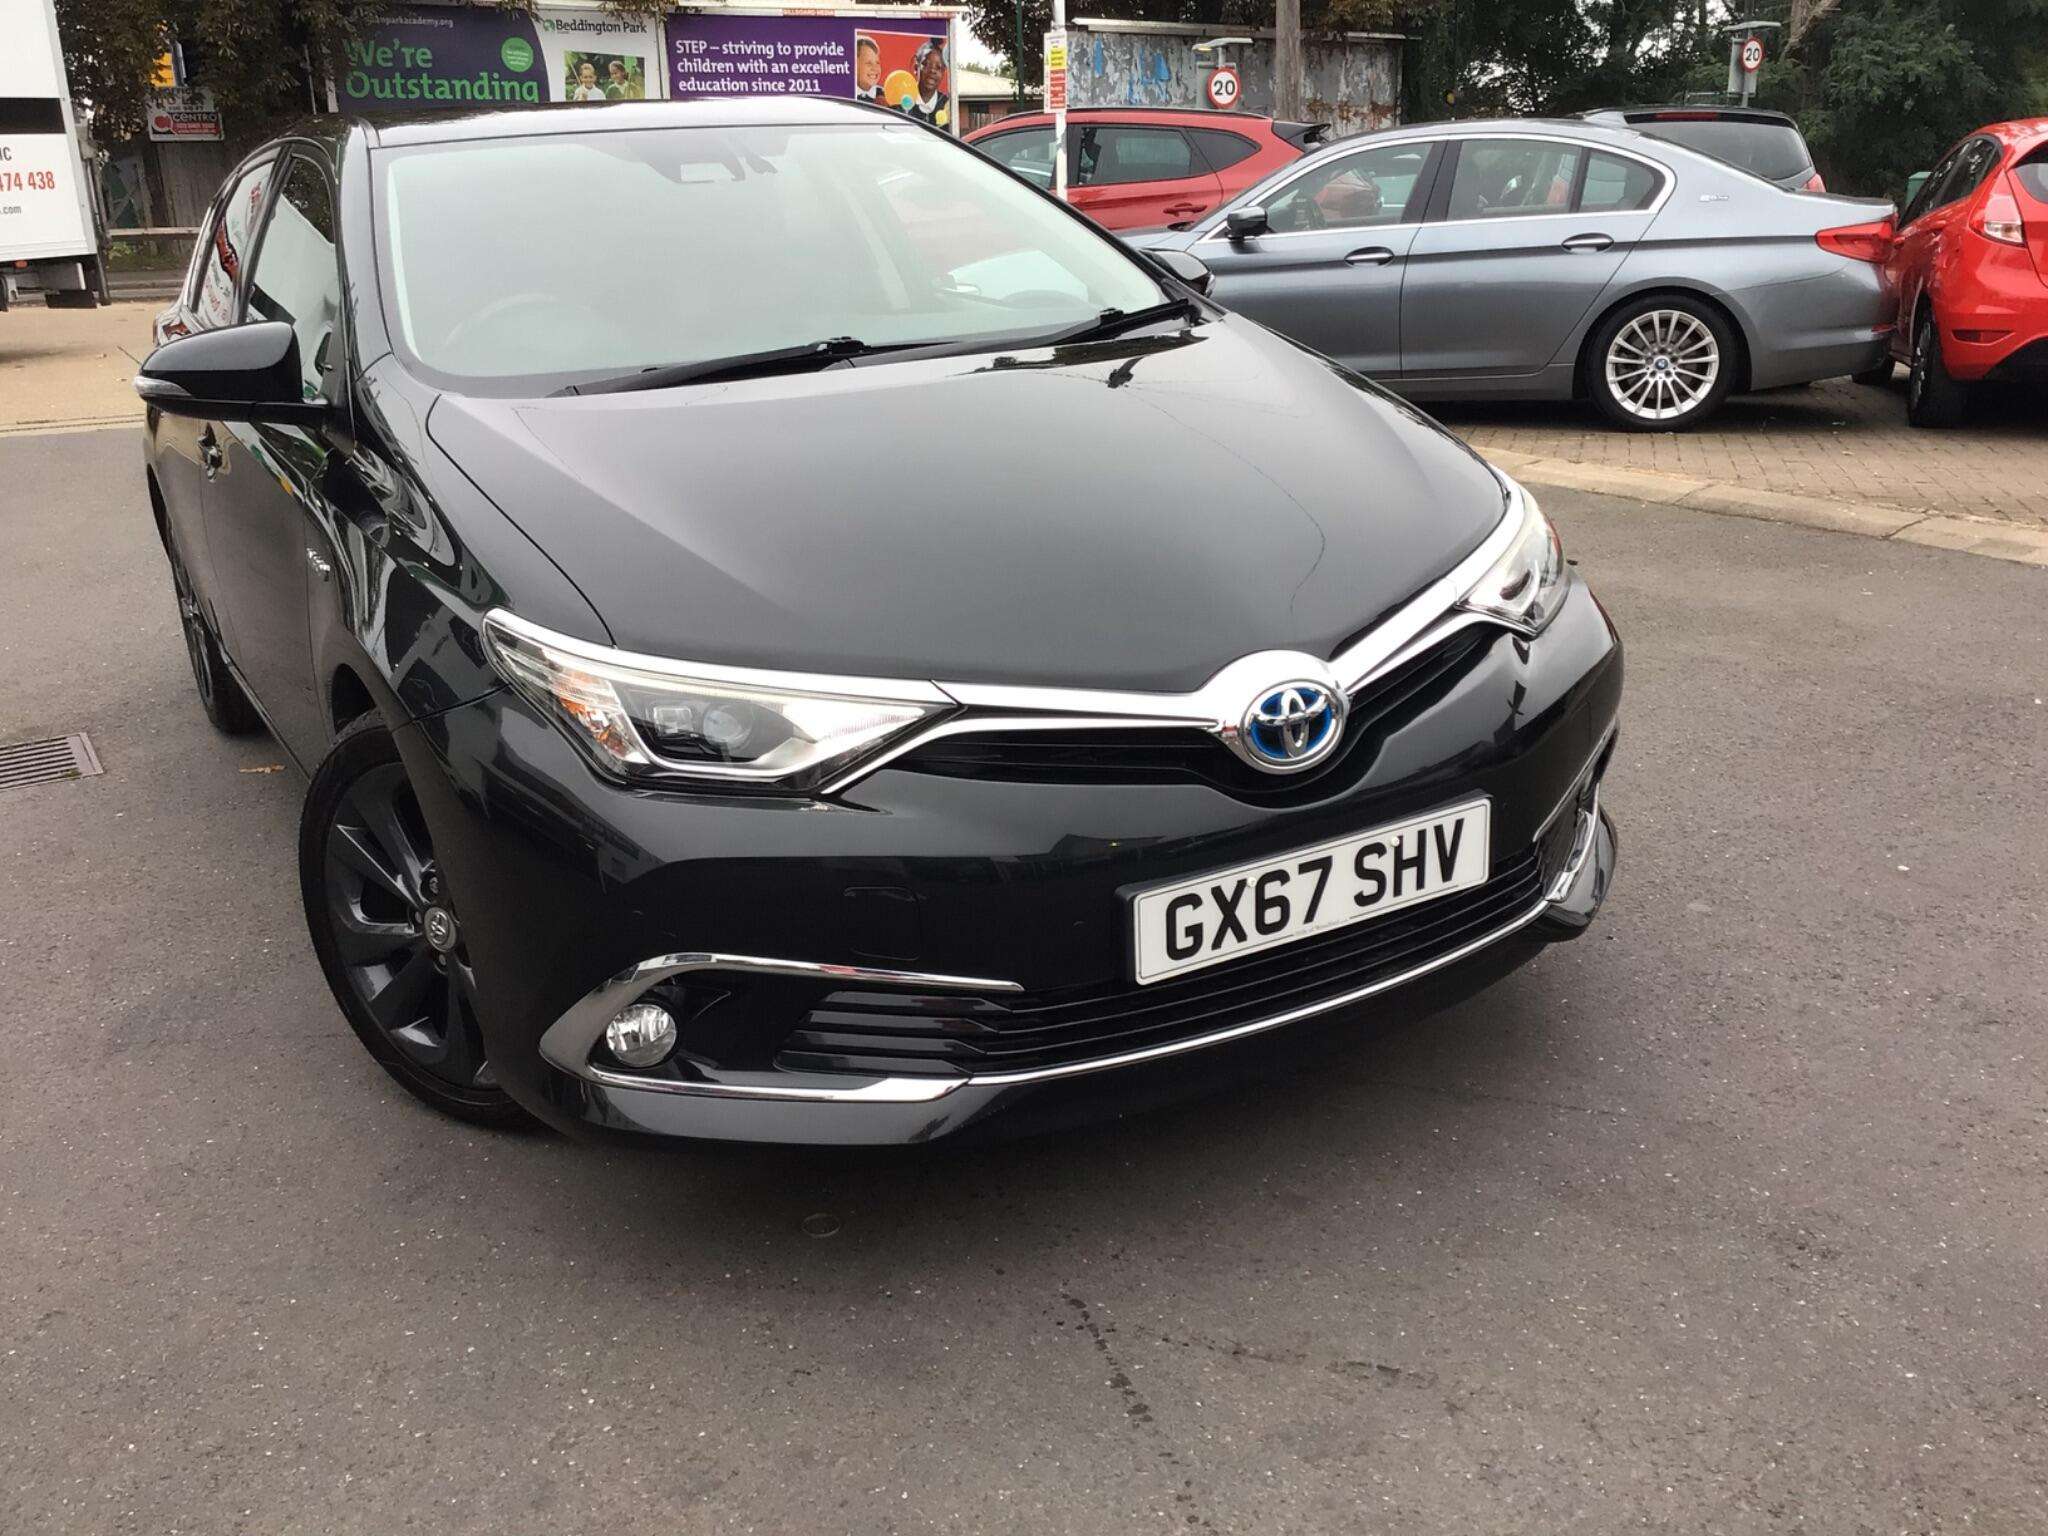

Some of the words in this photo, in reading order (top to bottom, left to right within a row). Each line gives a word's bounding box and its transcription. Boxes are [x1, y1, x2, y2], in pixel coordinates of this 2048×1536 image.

[556, 19, 620, 35] Beddington
[622, 21, 647, 34] Park
[343, 38, 433, 68] We're
[675, 40, 708, 54] STEP
[722, 41, 774, 59] striving
[777, 42, 792, 56] to
[794, 42, 845, 59] provide
[1745, 48, 1760, 62] 20
[677, 58, 735, 73] children
[737, 59, 769, 74] with
[771, 63, 789, 74] an
[791, 60, 850, 75] excellent
[346, 70, 540, 103] Outstanding
[678, 77, 749, 93] education
[752, 78, 786, 92] since
[788, 79, 822, 93] 2011
[1214, 80, 1236, 96] 20
[27, 170, 56, 190] 438
[1165, 856, 1334, 961] GX67
[1353, 817, 1465, 908] SHV
